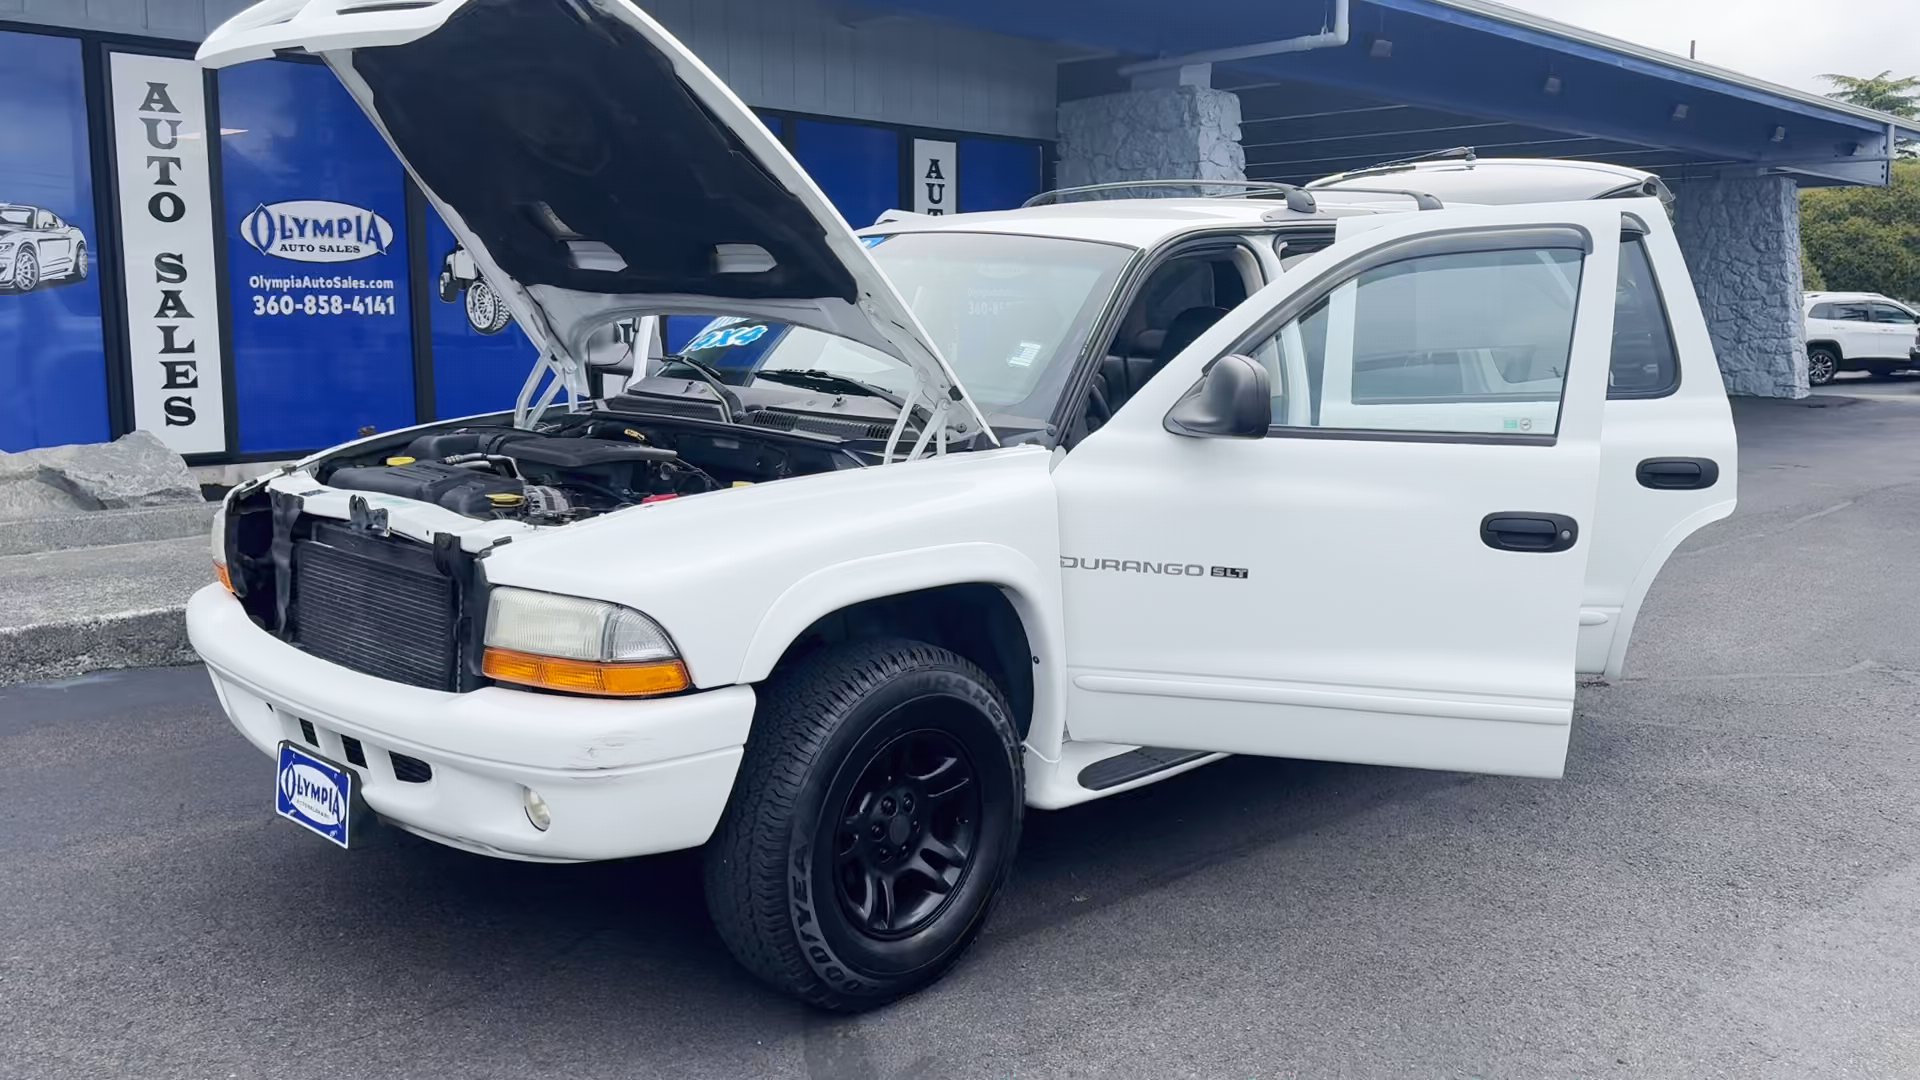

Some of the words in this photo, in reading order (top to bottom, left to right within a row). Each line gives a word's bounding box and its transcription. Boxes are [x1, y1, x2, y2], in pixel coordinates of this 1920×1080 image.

[138, 81, 186, 223] AUTO
[250, 203, 387, 255] OLYMPIA
[279, 243, 315, 253] AUTO
[318, 244, 361, 254] SALES
[249, 274, 394, 292] OlympiaAutoSales.com
[252, 294, 396, 316] 360-858-4141
[152, 252, 199, 427] SALES
[1060, 555, 1204, 577] DURANGO
[1211, 566, 1249, 580] SLT
[284, 762, 343, 828] OLYMPIA
